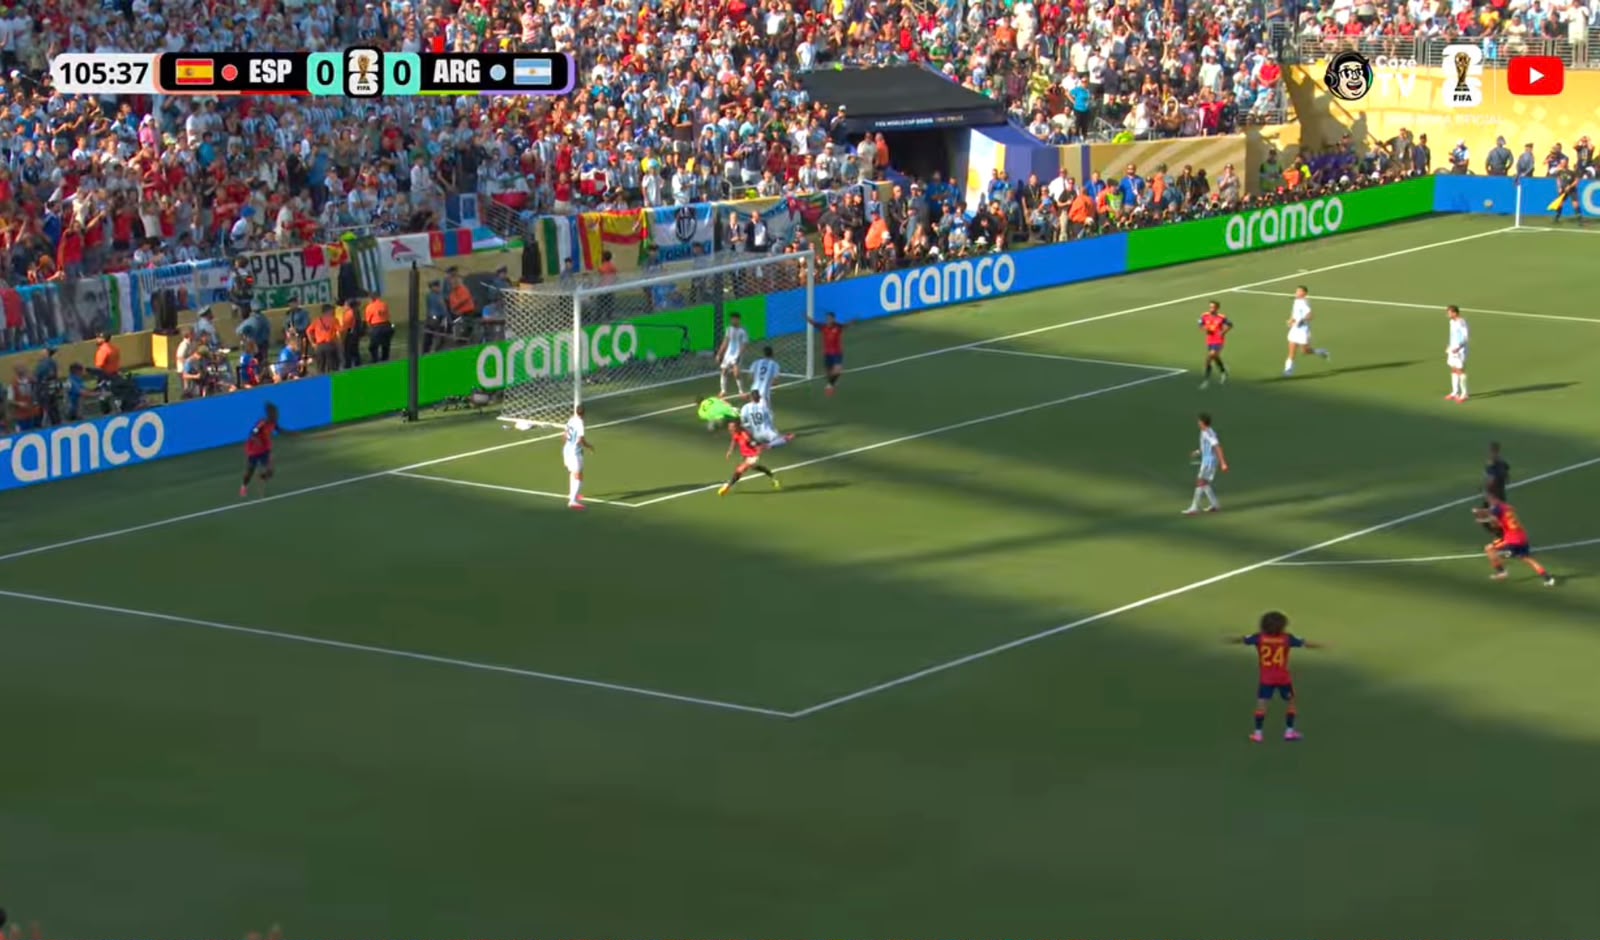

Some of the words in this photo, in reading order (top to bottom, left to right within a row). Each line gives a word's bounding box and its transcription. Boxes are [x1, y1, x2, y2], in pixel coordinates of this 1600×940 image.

[1226, 197, 1343, 250] aramco
[880, 254, 1015, 312] aramco
[476, 324, 638, 389] aramco
[1260, 645, 1285, 667] 24
